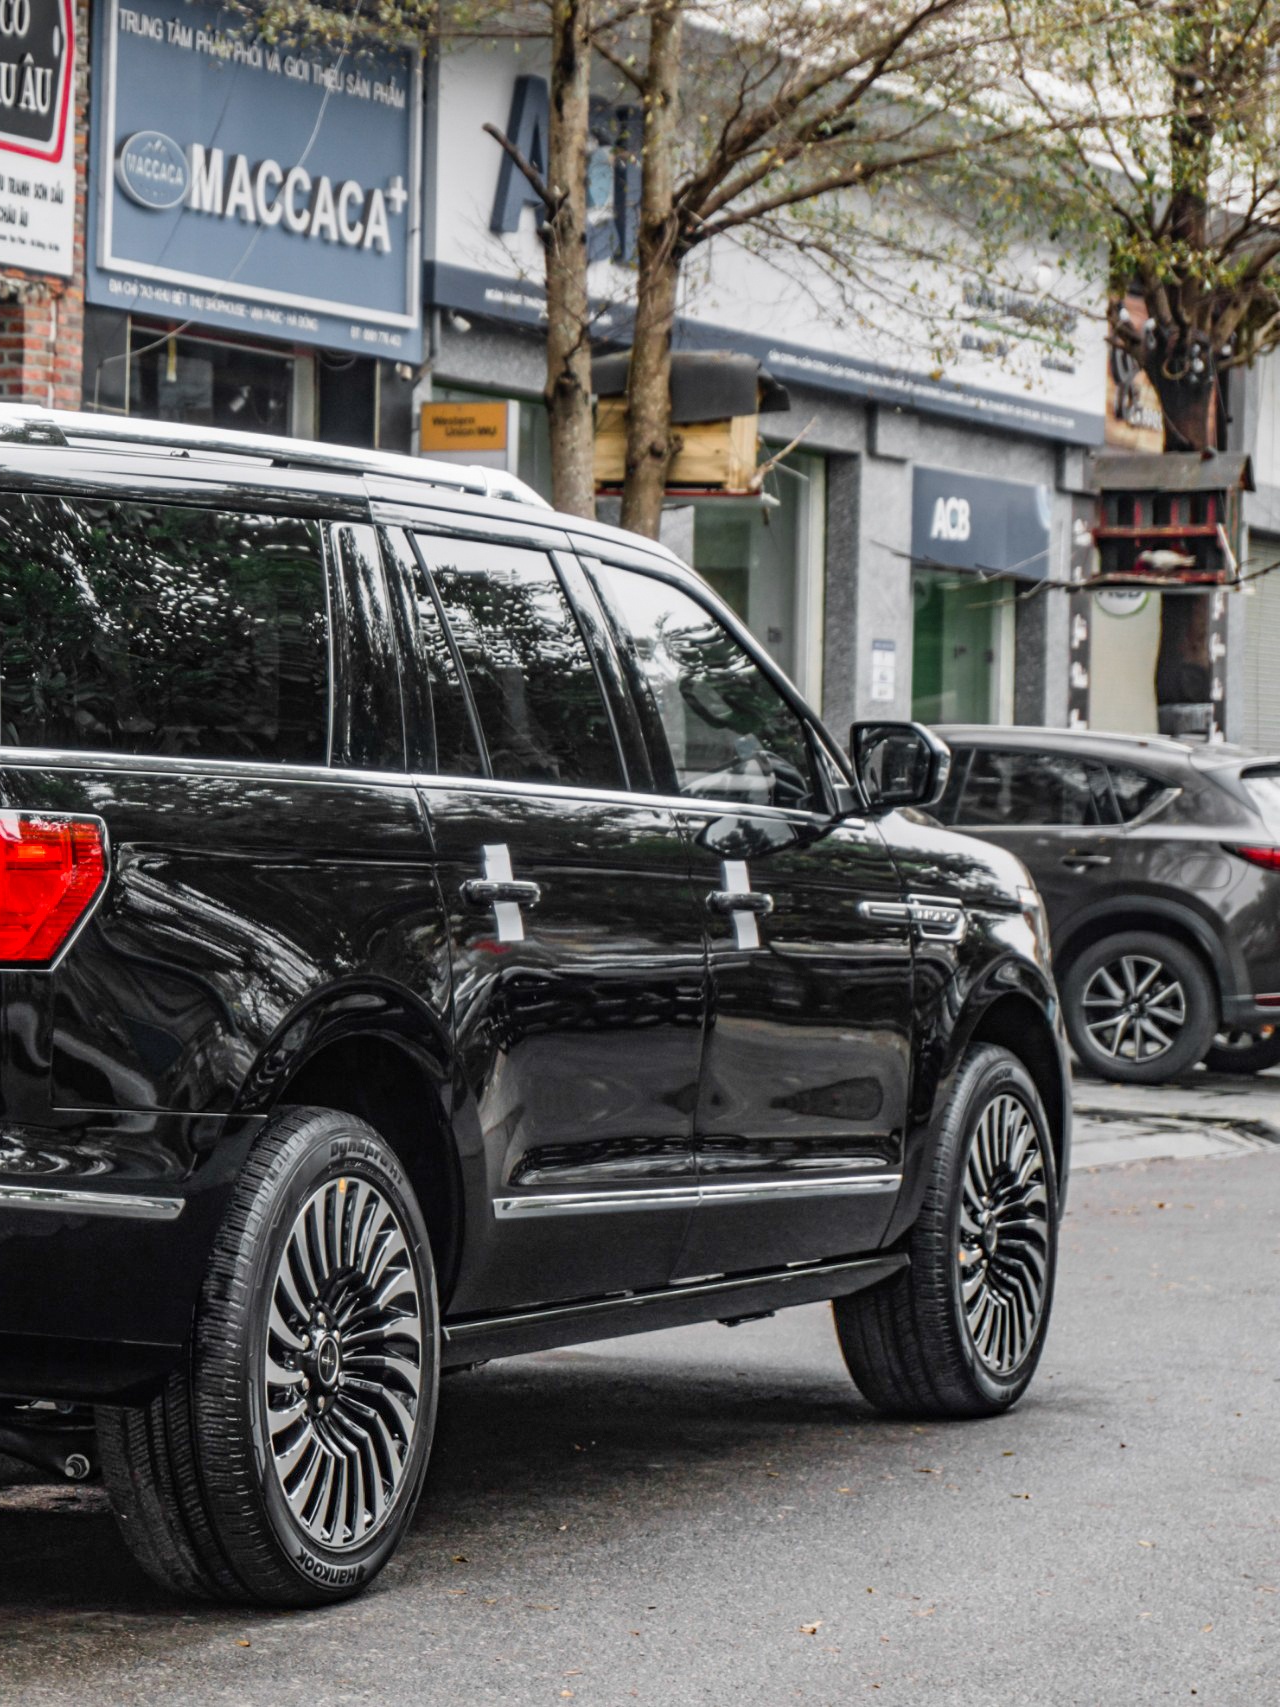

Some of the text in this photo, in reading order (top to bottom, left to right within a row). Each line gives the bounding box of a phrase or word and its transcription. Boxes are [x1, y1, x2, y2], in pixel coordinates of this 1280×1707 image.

[119, 8, 163, 41] TRUNG
[166, 18, 193, 49] TÂM
[19, 52, 53, 114] ÂU
[126, 152, 184, 187] MACCACA
[930, 496, 971, 541] ACB
